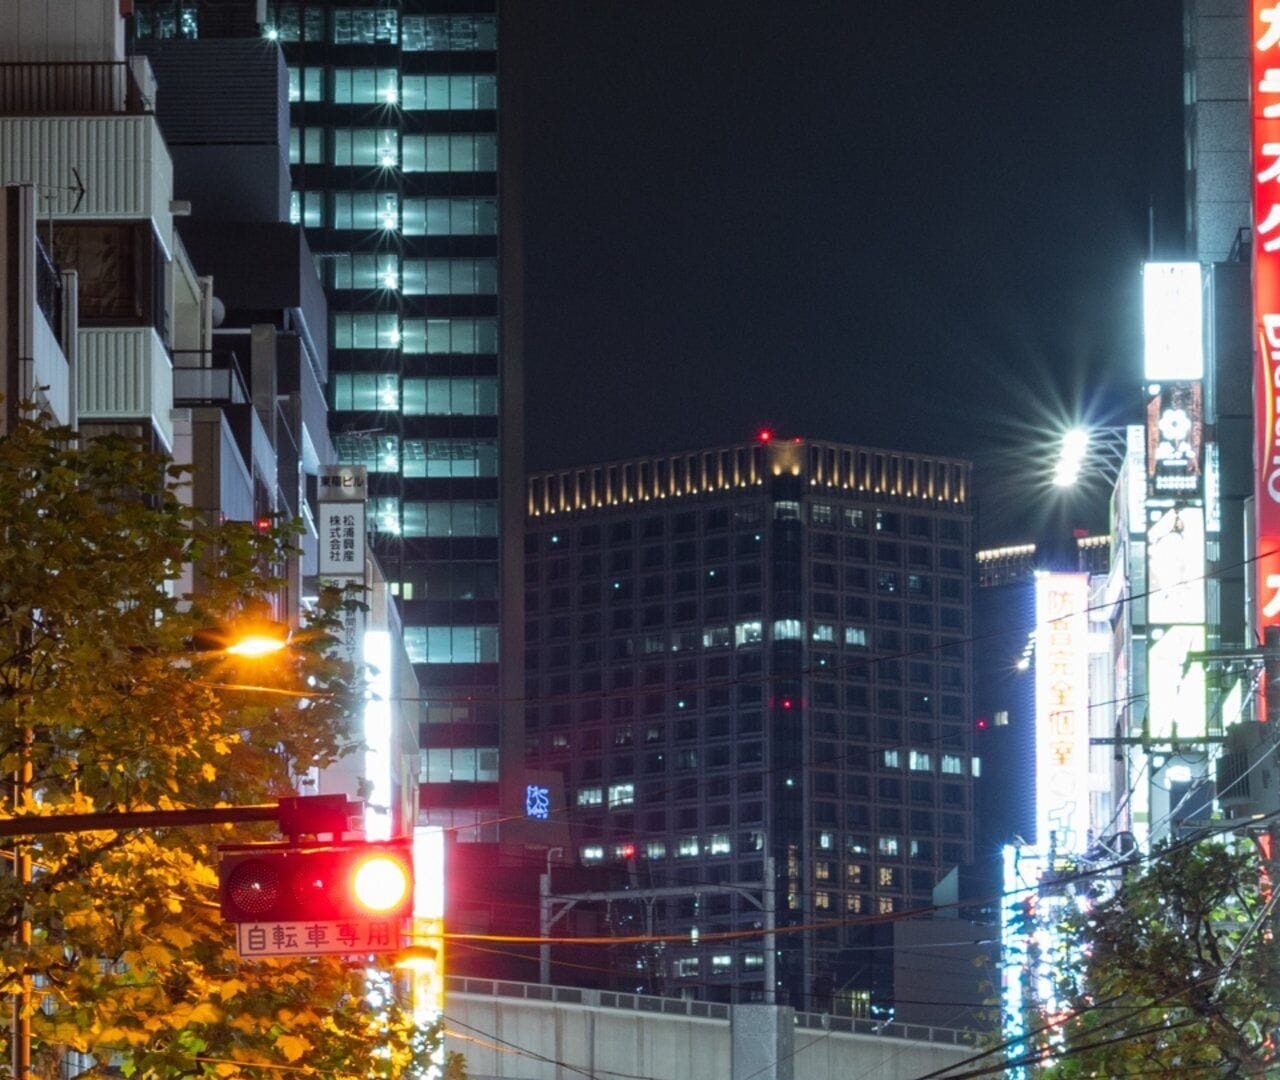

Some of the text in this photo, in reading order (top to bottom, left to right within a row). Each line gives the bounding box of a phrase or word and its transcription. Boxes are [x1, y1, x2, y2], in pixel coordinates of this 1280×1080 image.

[329, 514, 341, 562] 株式会社
[248, 923, 390, 951] 自転車専用
